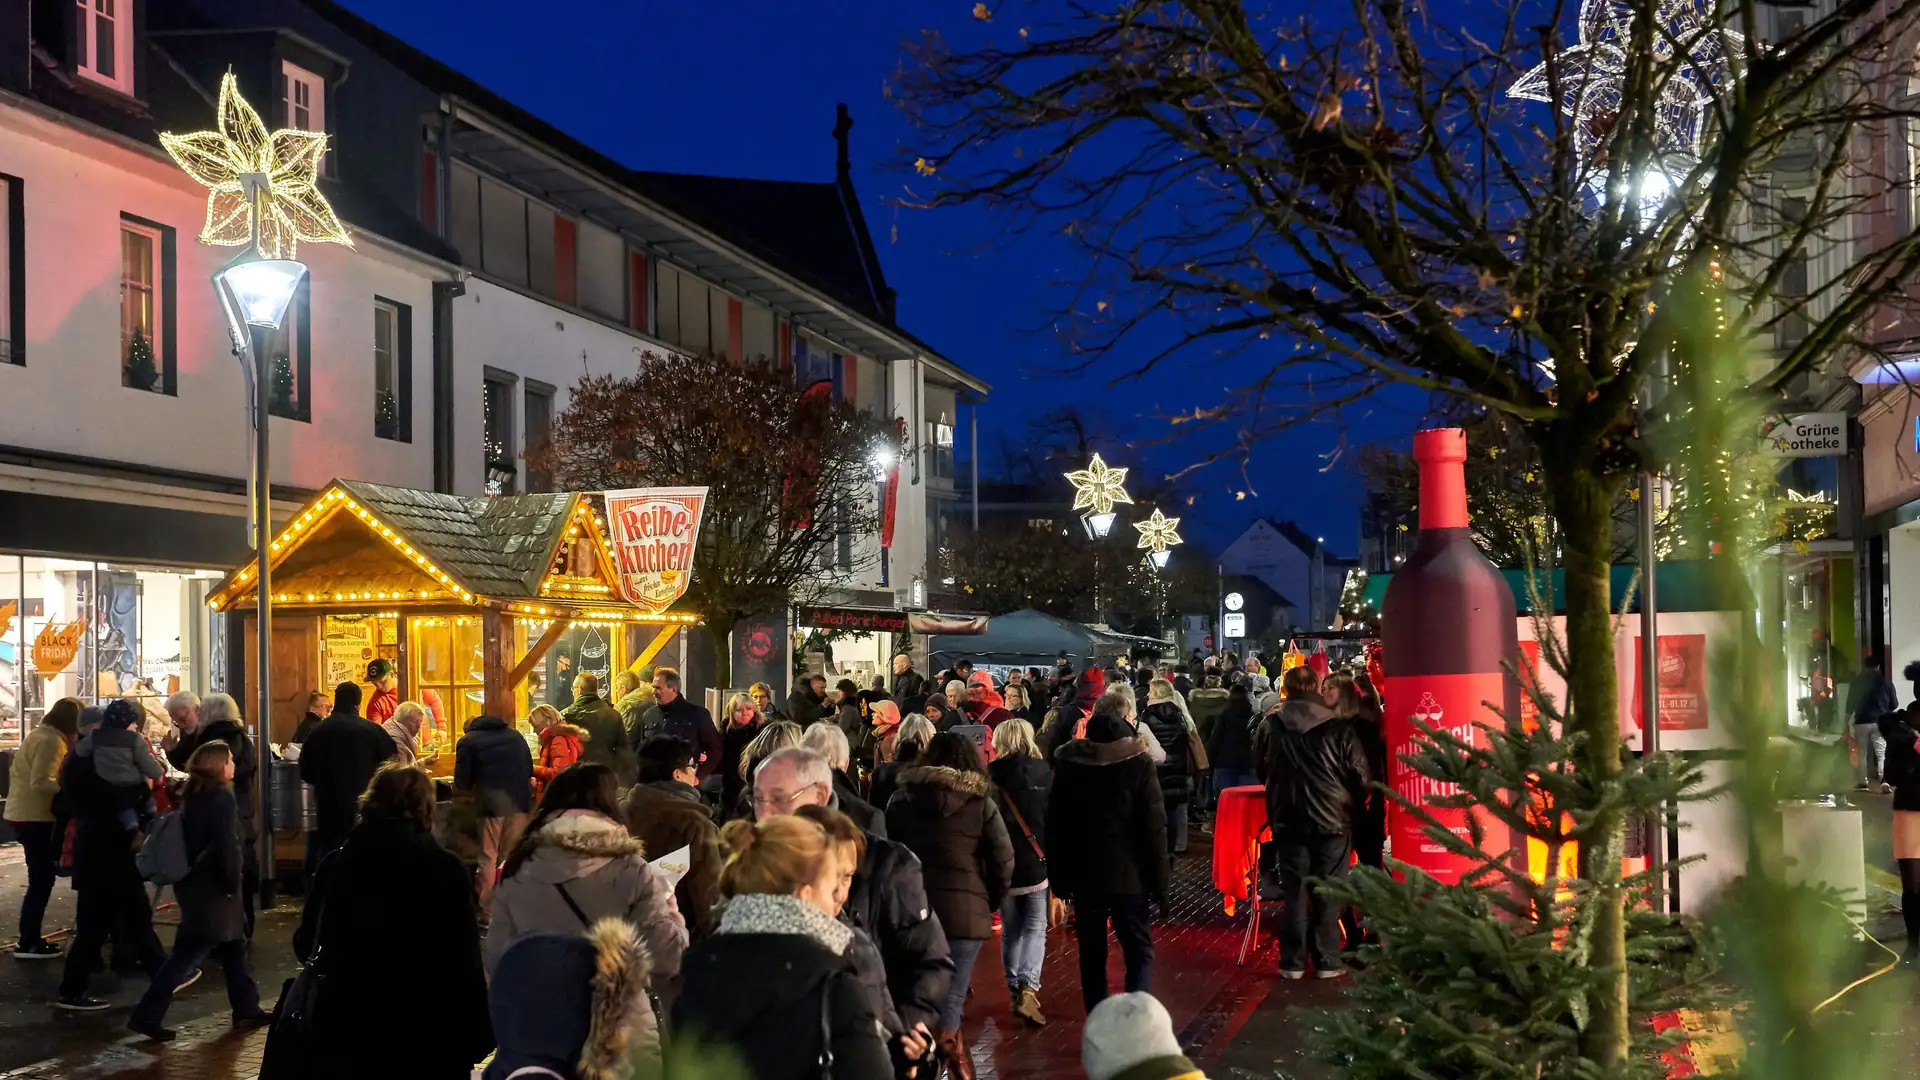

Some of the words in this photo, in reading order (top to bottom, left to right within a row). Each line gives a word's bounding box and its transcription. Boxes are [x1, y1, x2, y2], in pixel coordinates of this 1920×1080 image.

[1796, 424, 1840, 437] Grüne
[619, 506, 694, 542] Reibe-
[812, 609, 844, 625] Pulled
[845, 612, 870, 628] Pork
[871, 615, 907, 632] Burger
[41, 636, 72, 646] BLACK
[40, 647, 72, 659] FRIDAY
